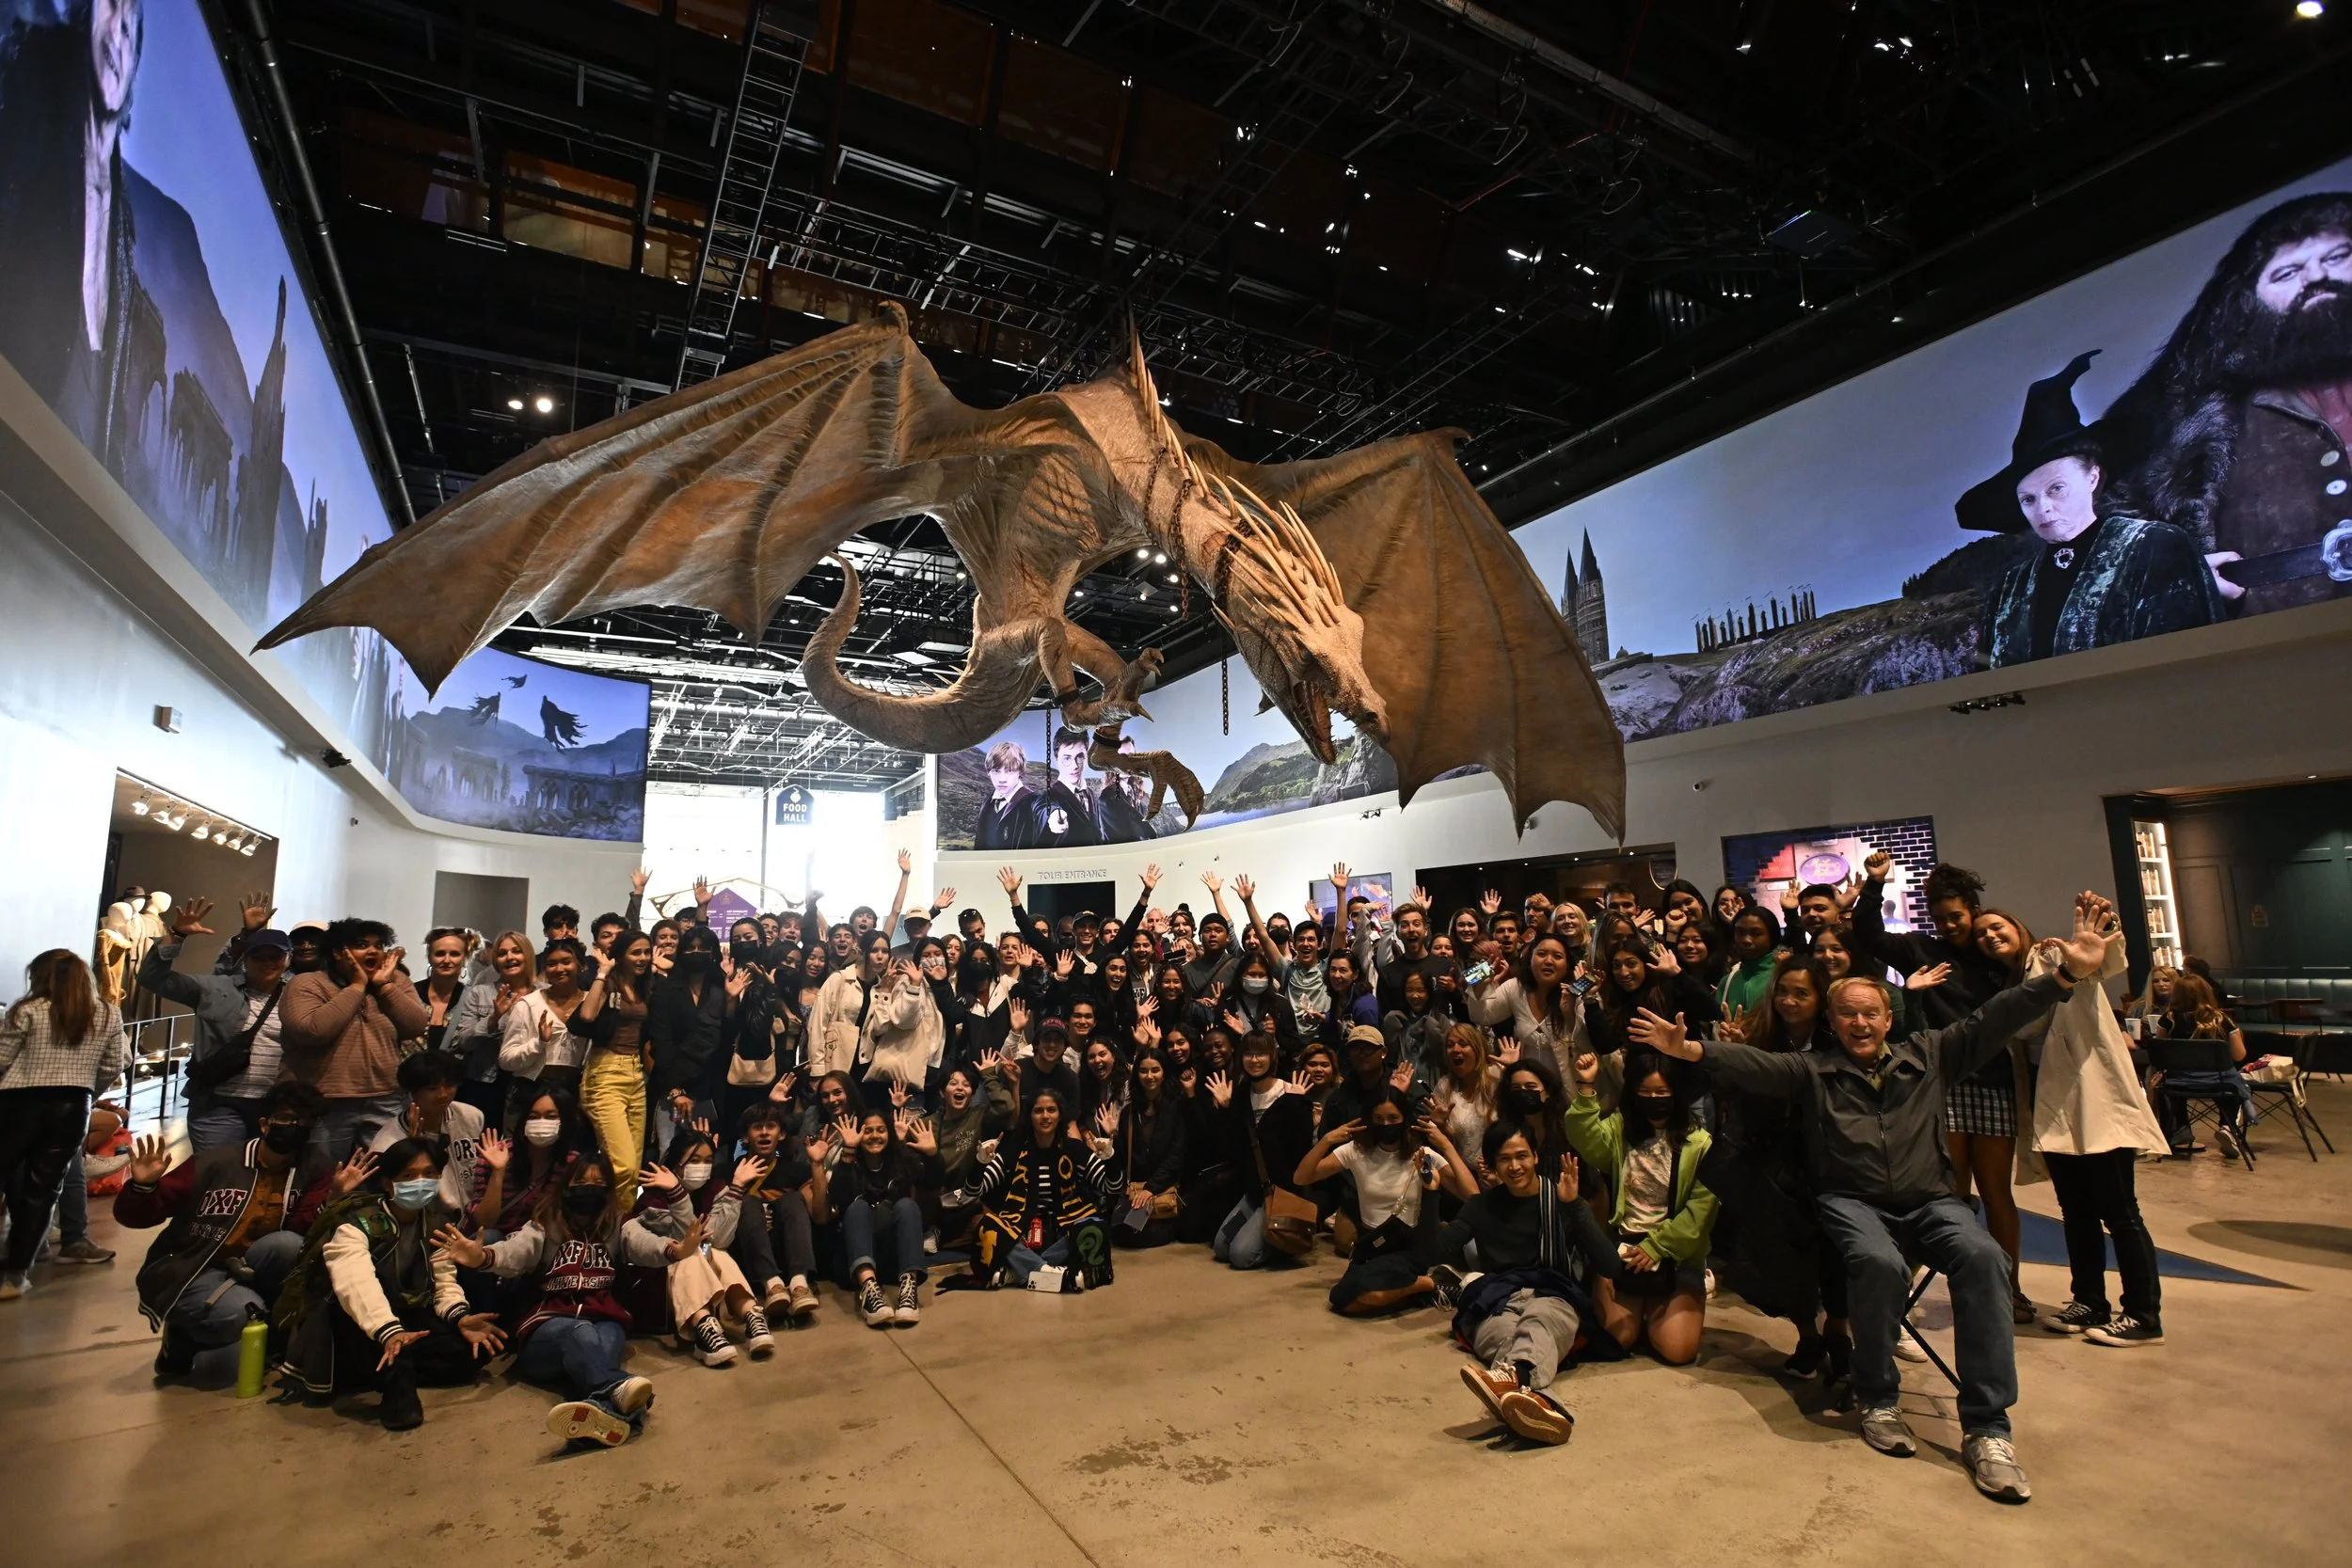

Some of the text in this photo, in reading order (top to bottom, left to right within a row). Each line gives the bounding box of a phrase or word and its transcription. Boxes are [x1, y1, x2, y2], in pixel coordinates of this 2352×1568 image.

[783, 803, 807, 812] FOOD
[783, 813, 806, 822] HALL
[1037, 868, 1107, 880] TOUR ENTRANCE
